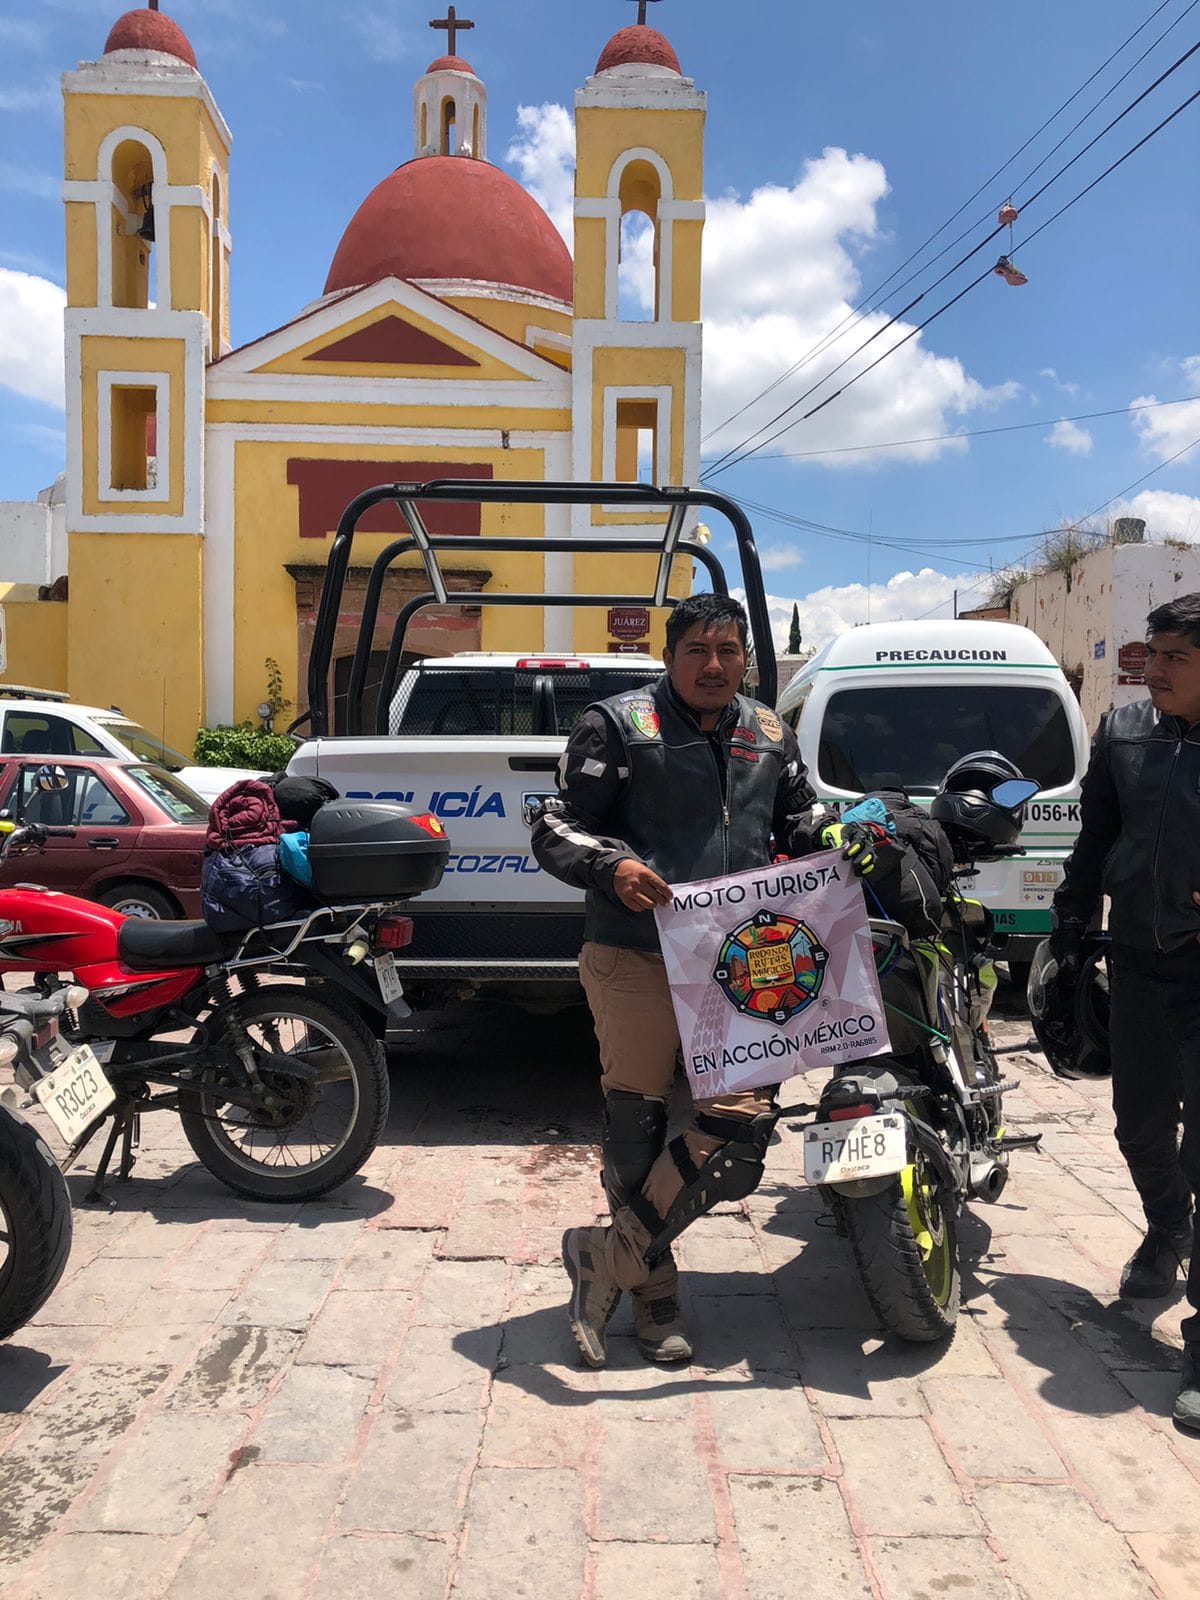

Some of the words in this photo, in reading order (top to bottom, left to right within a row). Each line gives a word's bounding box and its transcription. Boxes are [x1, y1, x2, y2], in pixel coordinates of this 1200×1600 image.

[612, 616, 646, 627] JUÁREZ
[875, 649, 1007, 661] PRECAUCION
[673, 885, 746, 912] MOTO
[752, 865, 841, 900] TURISTA
[759, 914, 771, 923] N
[815, 952, 826, 961] E
[716, 970, 728, 979] O
[775, 1011, 786, 1020] S
[692, 1054, 717, 1075] EN
[722, 1034, 800, 1068] ACCIÓN
[803, 1014, 876, 1048] MÉXICO
[55, 1070, 99, 1120] R3CZ3
[822, 1133, 886, 1164] R7HE8
